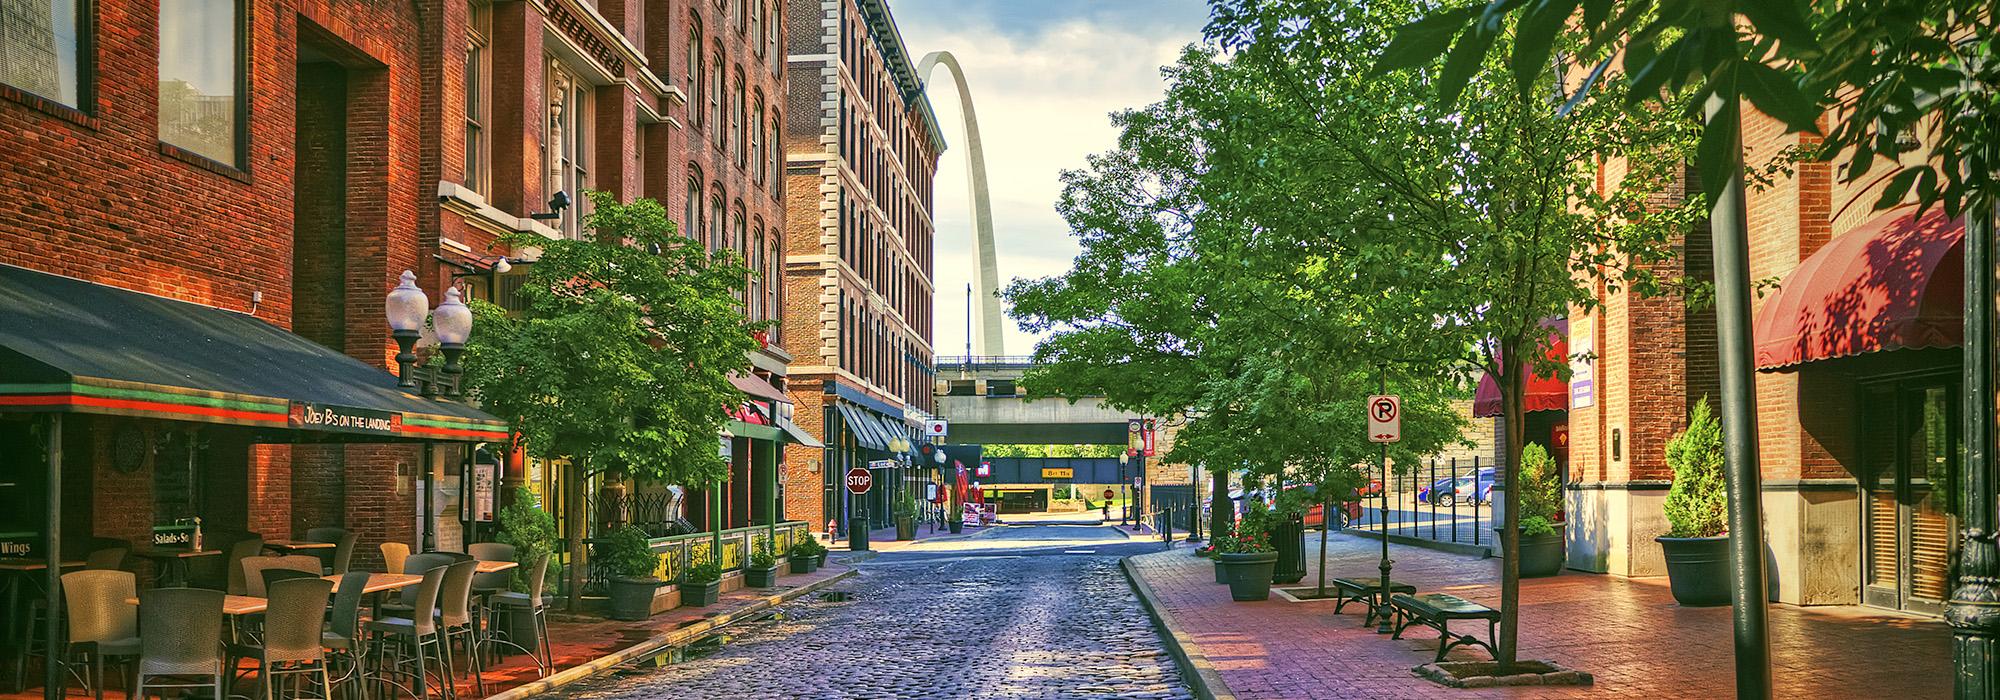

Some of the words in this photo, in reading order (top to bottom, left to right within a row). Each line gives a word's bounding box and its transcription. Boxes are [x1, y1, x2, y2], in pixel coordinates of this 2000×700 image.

[305, 405, 324, 424] JOEY
[340, 415, 350, 427] ON
[351, 416, 364, 428] THE
[365, 418, 391, 430] LANDING
[848, 475, 870, 486] STOP
[155, 532, 177, 544] Salads
[1, 541, 31, 556] Wings
